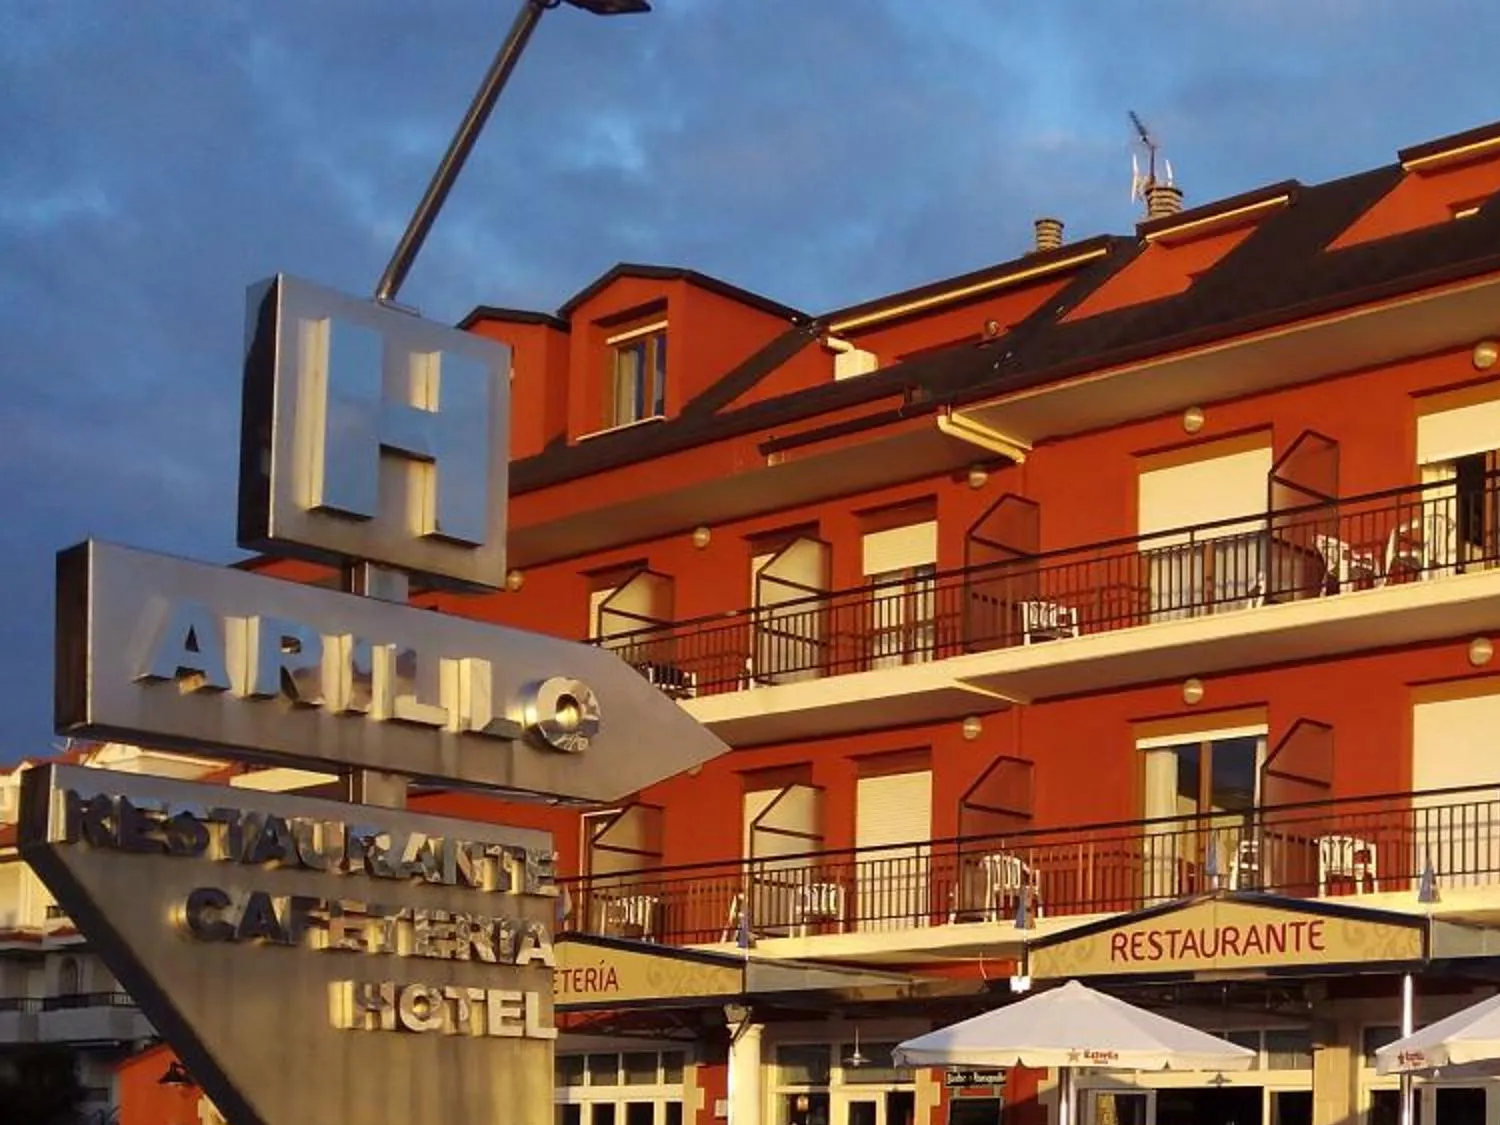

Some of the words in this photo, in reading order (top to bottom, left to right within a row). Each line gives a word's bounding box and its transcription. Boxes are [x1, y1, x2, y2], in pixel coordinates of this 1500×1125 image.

[305, 316, 492, 548] H
[134, 603, 601, 753] ARILLO
[52, 790, 559, 897] RESTAURANTE
[172, 887, 557, 967] CAFETERIA
[1110, 919, 1326, 962] RESTAURANTE
[329, 980, 558, 1040] HOTEL
